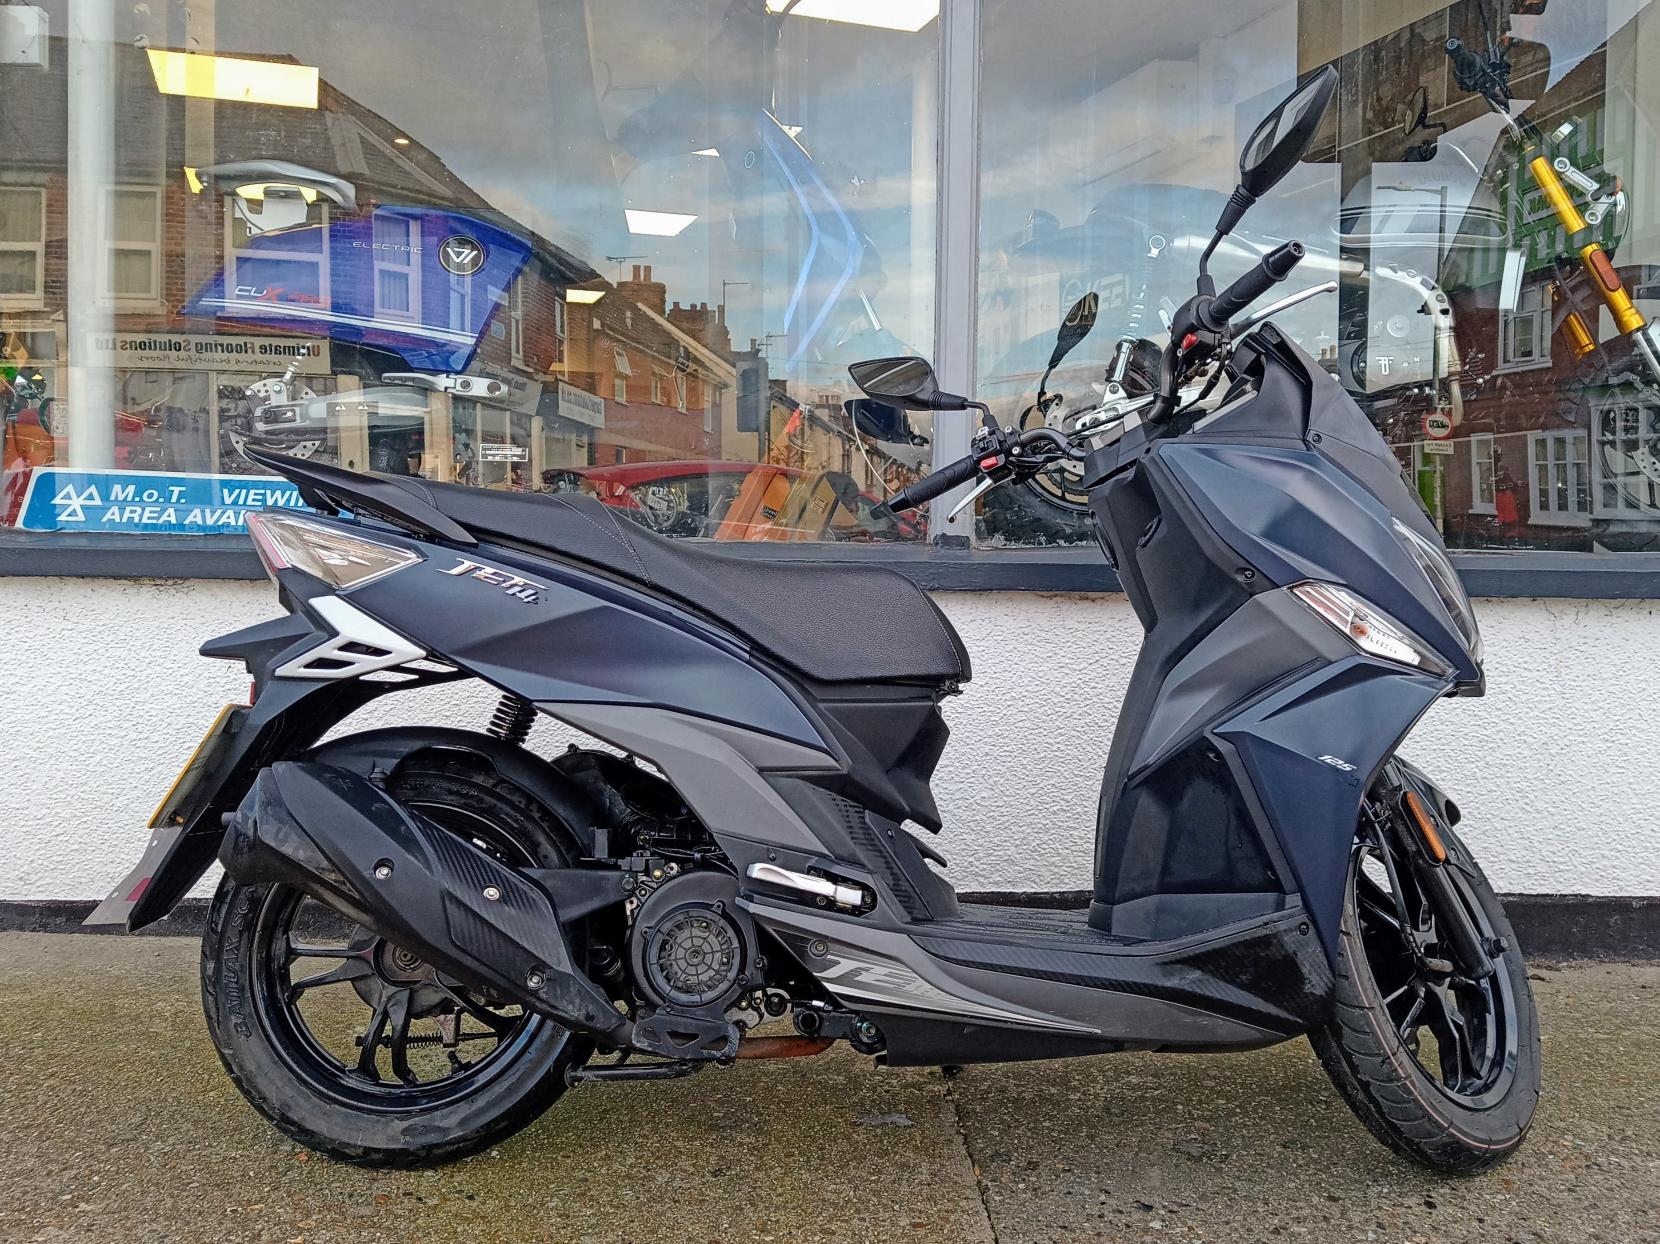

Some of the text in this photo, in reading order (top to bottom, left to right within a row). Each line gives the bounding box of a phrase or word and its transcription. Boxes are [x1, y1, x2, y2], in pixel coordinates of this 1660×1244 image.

[352, 240, 424, 254] ELECTRIC
[234, 285, 284, 303] CUX
[110, 484, 187, 503] M.o.T.
[101, 506, 177, 524] AREA
[1318, 755, 1357, 771] 125
